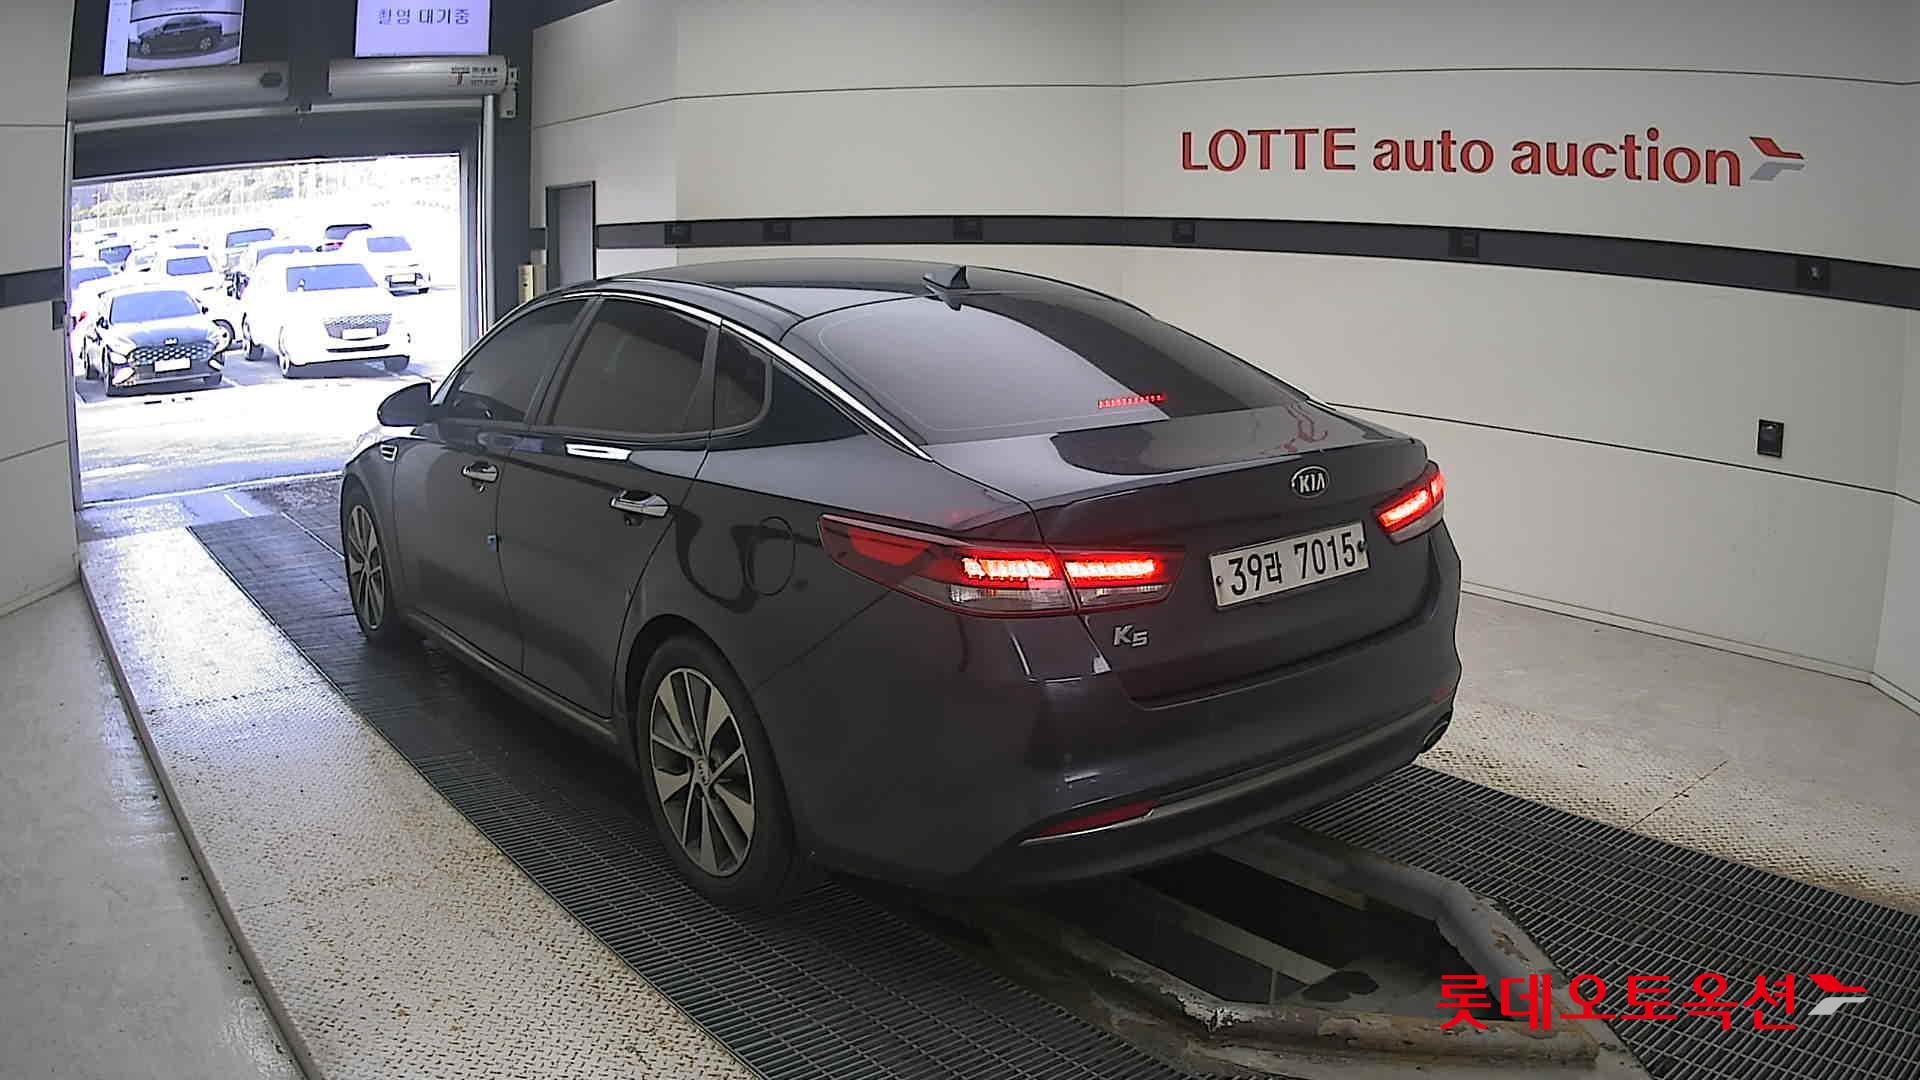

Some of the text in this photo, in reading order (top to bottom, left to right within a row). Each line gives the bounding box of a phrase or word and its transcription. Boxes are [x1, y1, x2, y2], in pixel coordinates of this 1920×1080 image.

[419, 8, 470, 25] 대기중
[1181, 127, 1742, 187] LOTTE auto auction
[1299, 472, 1325, 493] KIA
[1228, 532, 1356, 596] 39라 7015
[1113, 624, 1148, 647] K5
